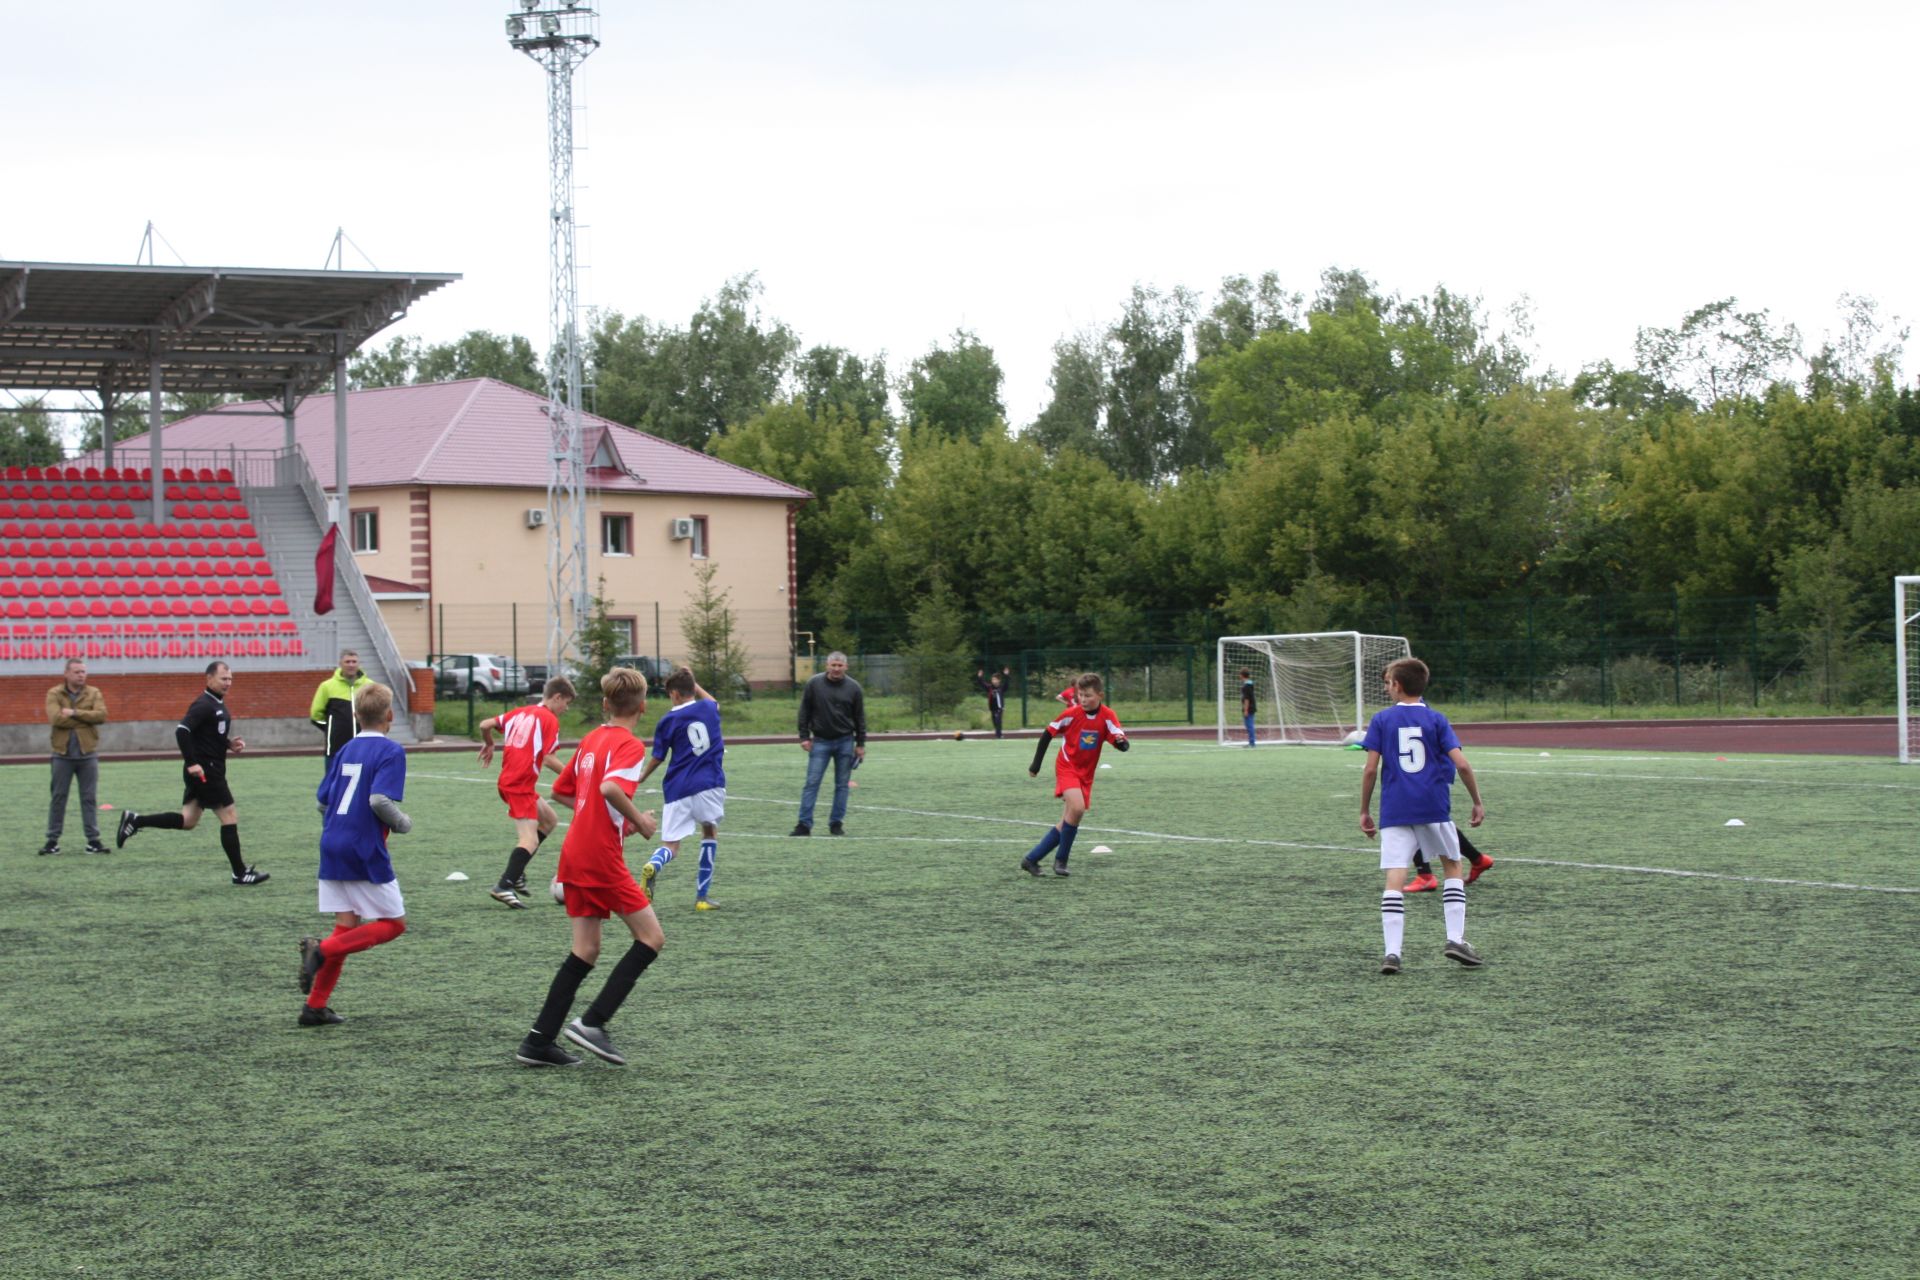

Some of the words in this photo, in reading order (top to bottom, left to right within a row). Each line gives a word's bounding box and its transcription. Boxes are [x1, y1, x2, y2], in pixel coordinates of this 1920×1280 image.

[687, 721, 710, 757] 9
[1398, 726, 1426, 773] 5
[336, 763, 363, 815] 7
